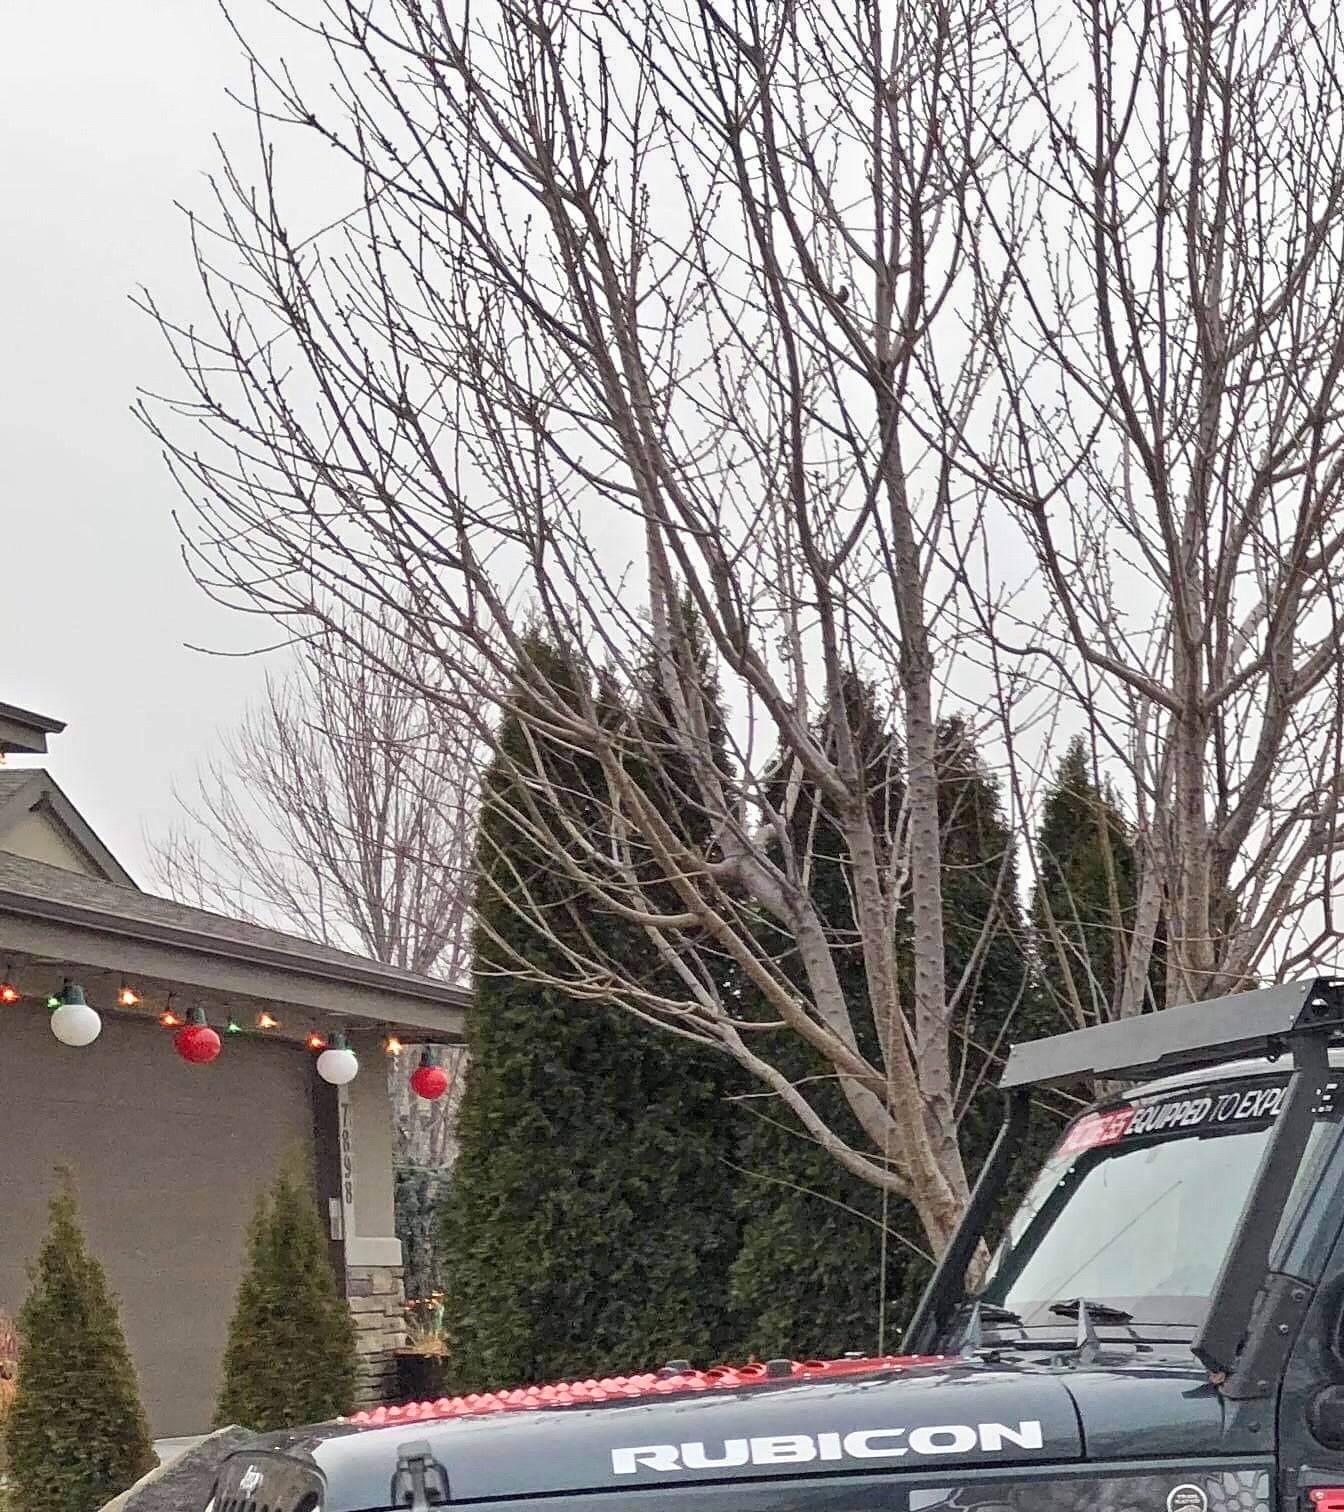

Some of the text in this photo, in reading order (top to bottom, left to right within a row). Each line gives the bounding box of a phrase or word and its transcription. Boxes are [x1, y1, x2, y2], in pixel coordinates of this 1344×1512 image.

[1124, 1098, 1212, 1135] EQUIPPED
[1208, 1093, 1241, 1122] TO
[610, 1420, 1044, 1475] RUBICON
